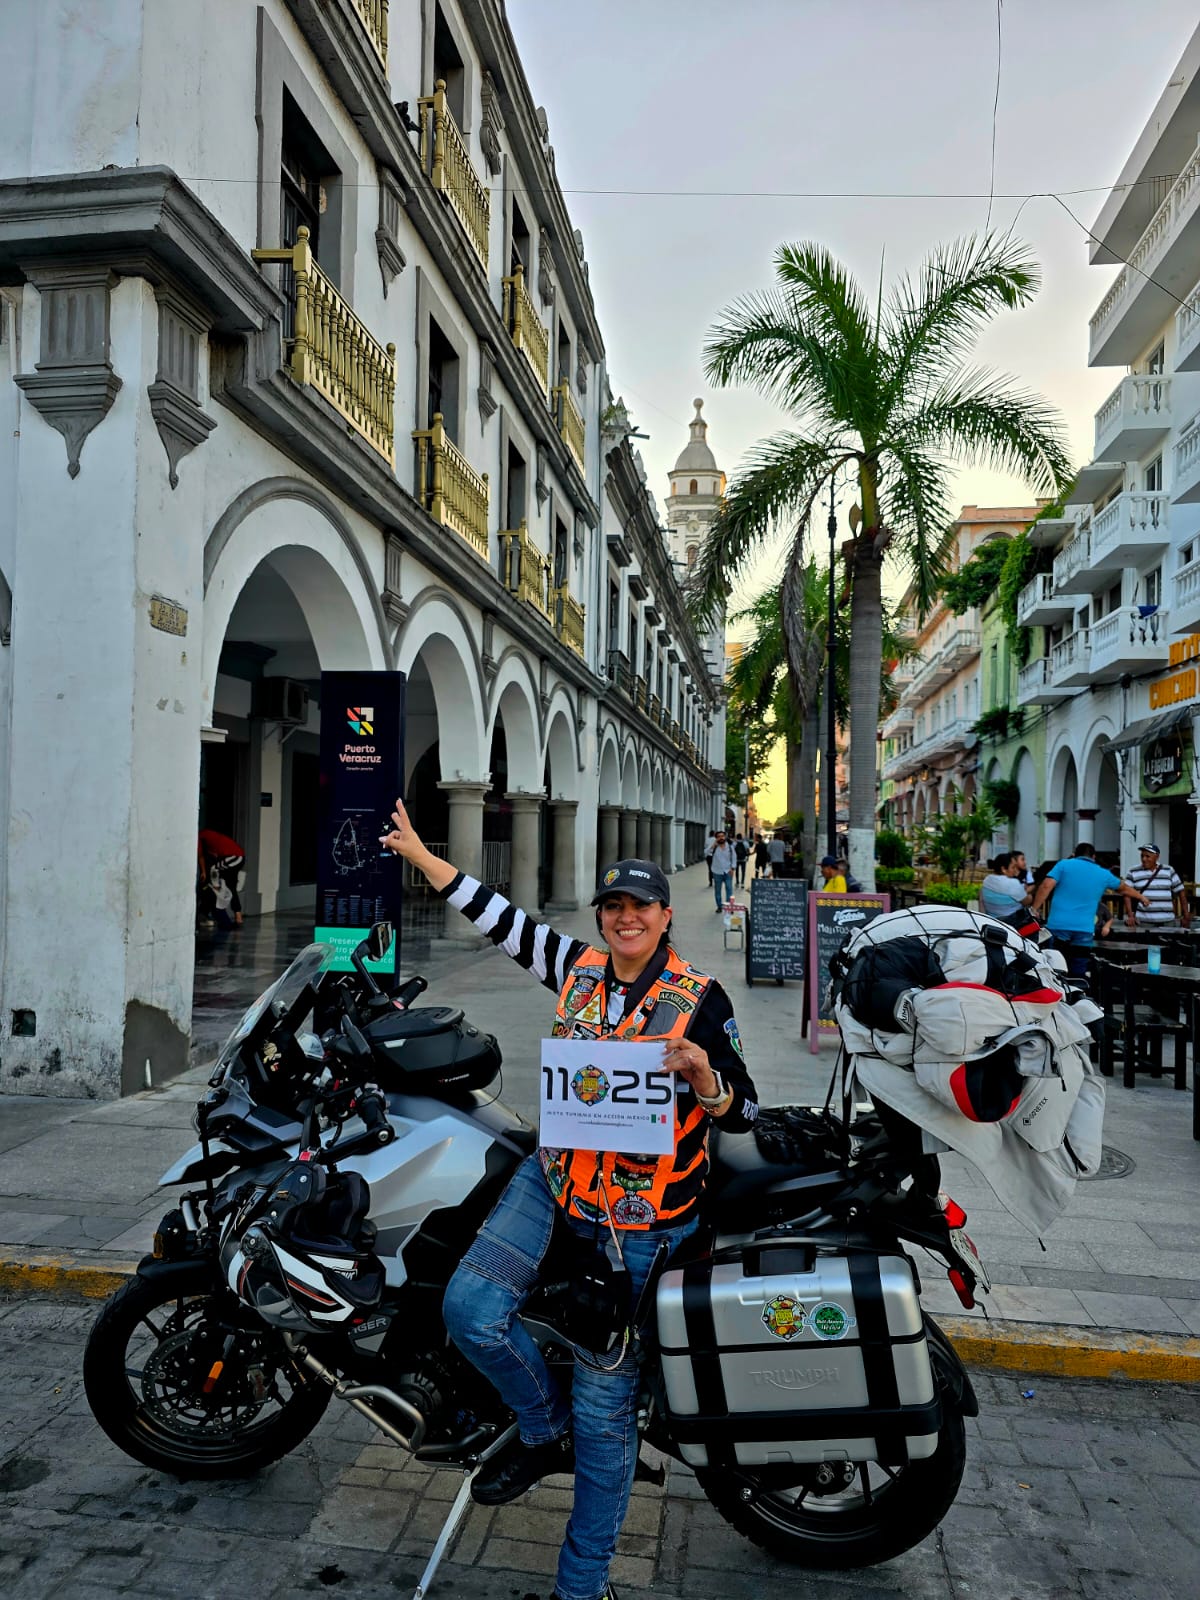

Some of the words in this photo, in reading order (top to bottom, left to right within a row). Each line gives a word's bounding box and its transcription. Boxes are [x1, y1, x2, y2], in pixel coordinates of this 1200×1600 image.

[344, 744, 376, 753] Puerto
[339, 753, 382, 763] Veracruz
[1143, 760, 1150, 776] LA
[768, 963, 804, 976] $155
[659, 992, 690, 1012] ARABELLA
[353, 1317, 387, 1333] IGER
[748, 1367, 840, 1386] TRIUMPH
